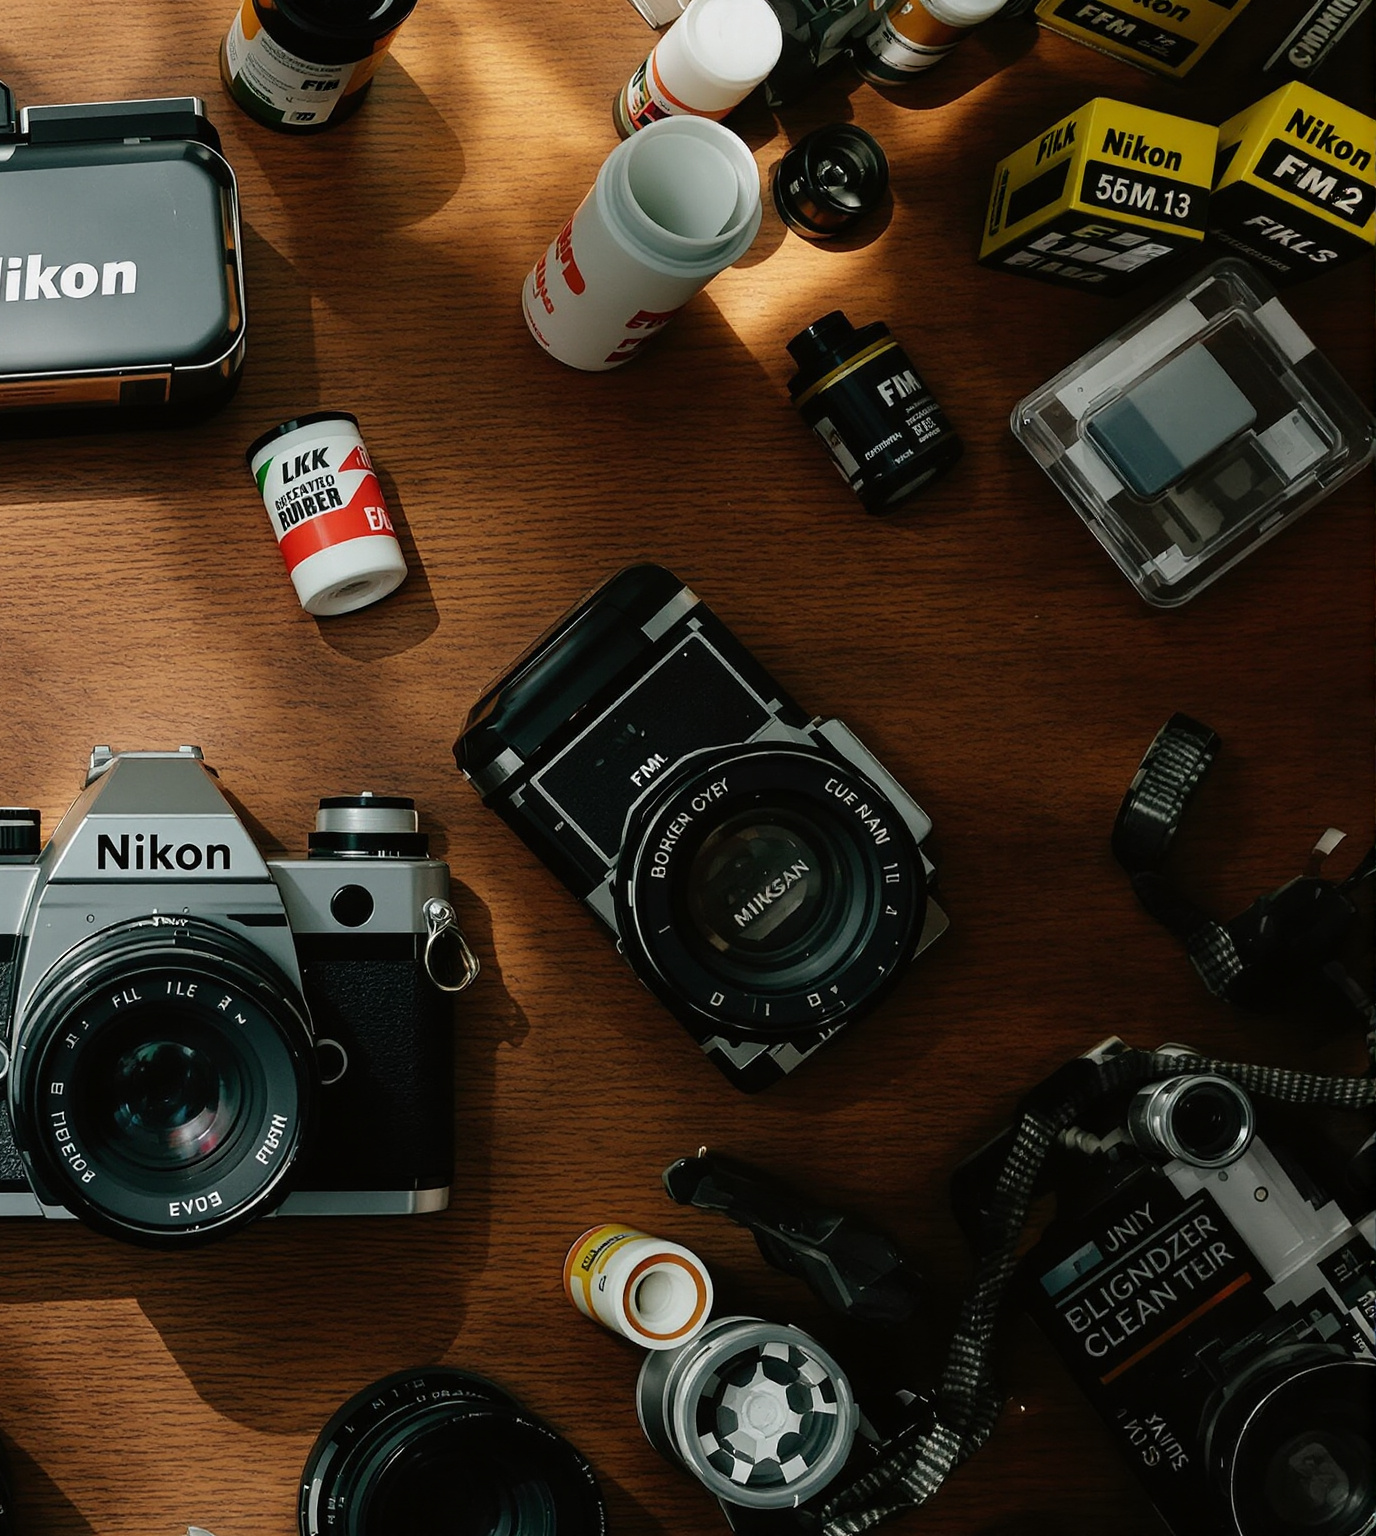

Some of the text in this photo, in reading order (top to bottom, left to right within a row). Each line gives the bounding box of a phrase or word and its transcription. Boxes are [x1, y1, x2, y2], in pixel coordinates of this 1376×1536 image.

[1101, 128, 1183, 172] Nikon
[1284, 107, 1372, 172] Nikon
[97, 834, 231, 871] Nikon
[1084, 1281, 1178, 1358] CLEAN
